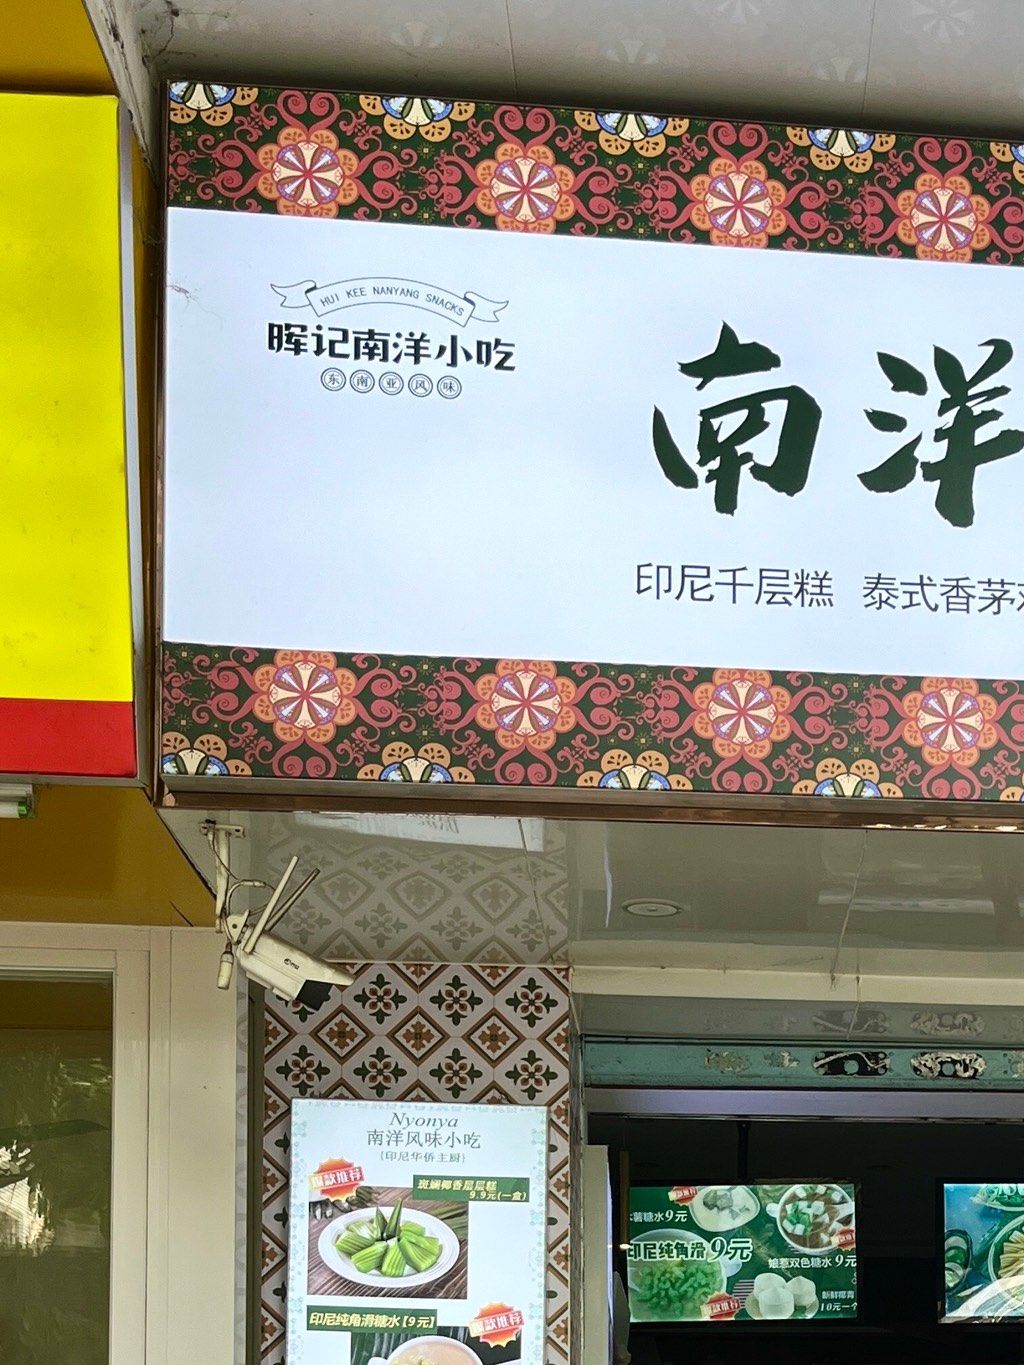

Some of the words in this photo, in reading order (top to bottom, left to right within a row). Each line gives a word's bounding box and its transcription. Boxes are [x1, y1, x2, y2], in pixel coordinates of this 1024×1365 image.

[320, 293, 340, 308] HUI
[346, 287, 367, 300] KEE
[372, 286, 419, 300] NANYANG
[425, 293, 465, 317] SNACKS
[267, 322, 516, 372] 晖记南洋小吃
[635, 562, 834, 610] 印尼千层糕
[388, 1112, 459, 1129] Nyonya
[366, 1129, 481, 1150] 南洋风味小吃
